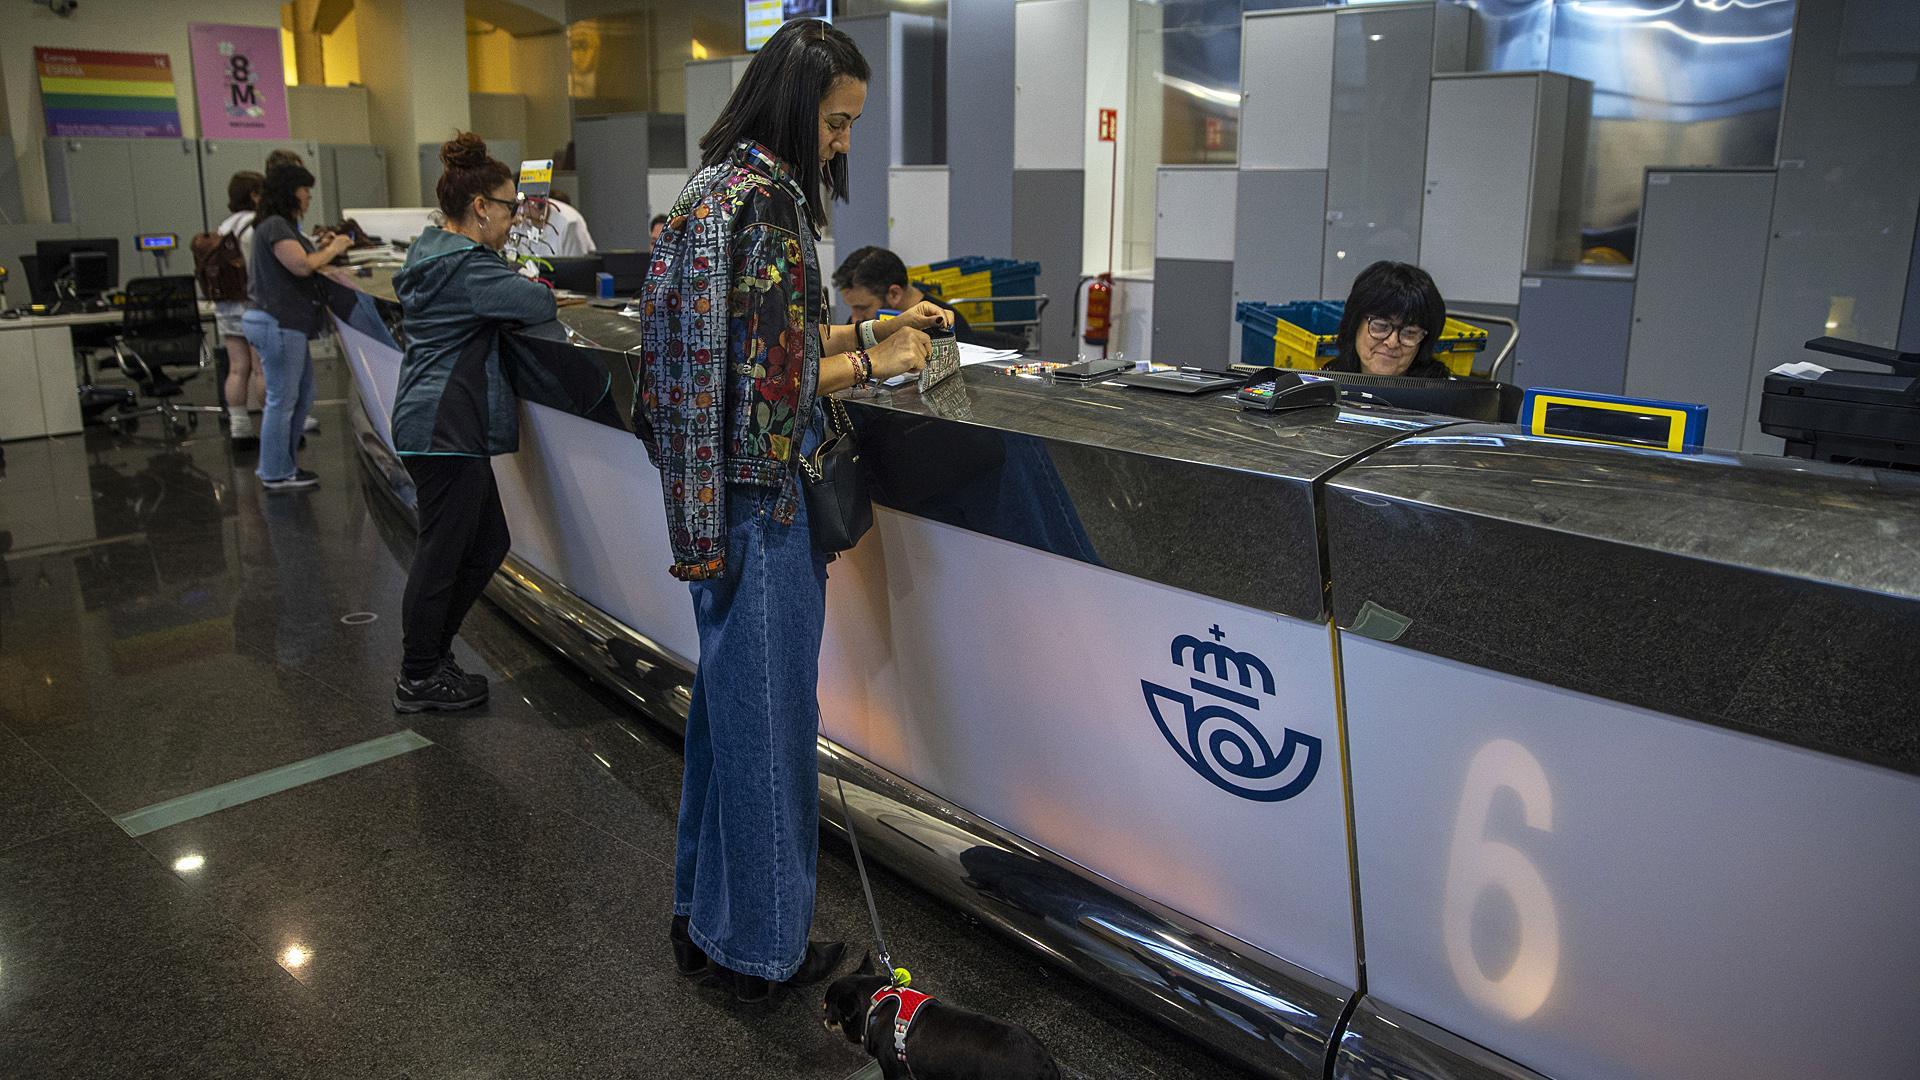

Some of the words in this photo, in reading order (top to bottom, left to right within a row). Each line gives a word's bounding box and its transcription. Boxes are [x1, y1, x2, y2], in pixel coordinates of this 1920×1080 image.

[230, 54, 249, 82] 8
[231, 83, 256, 107] M
[1443, 738, 1559, 1022] 6
